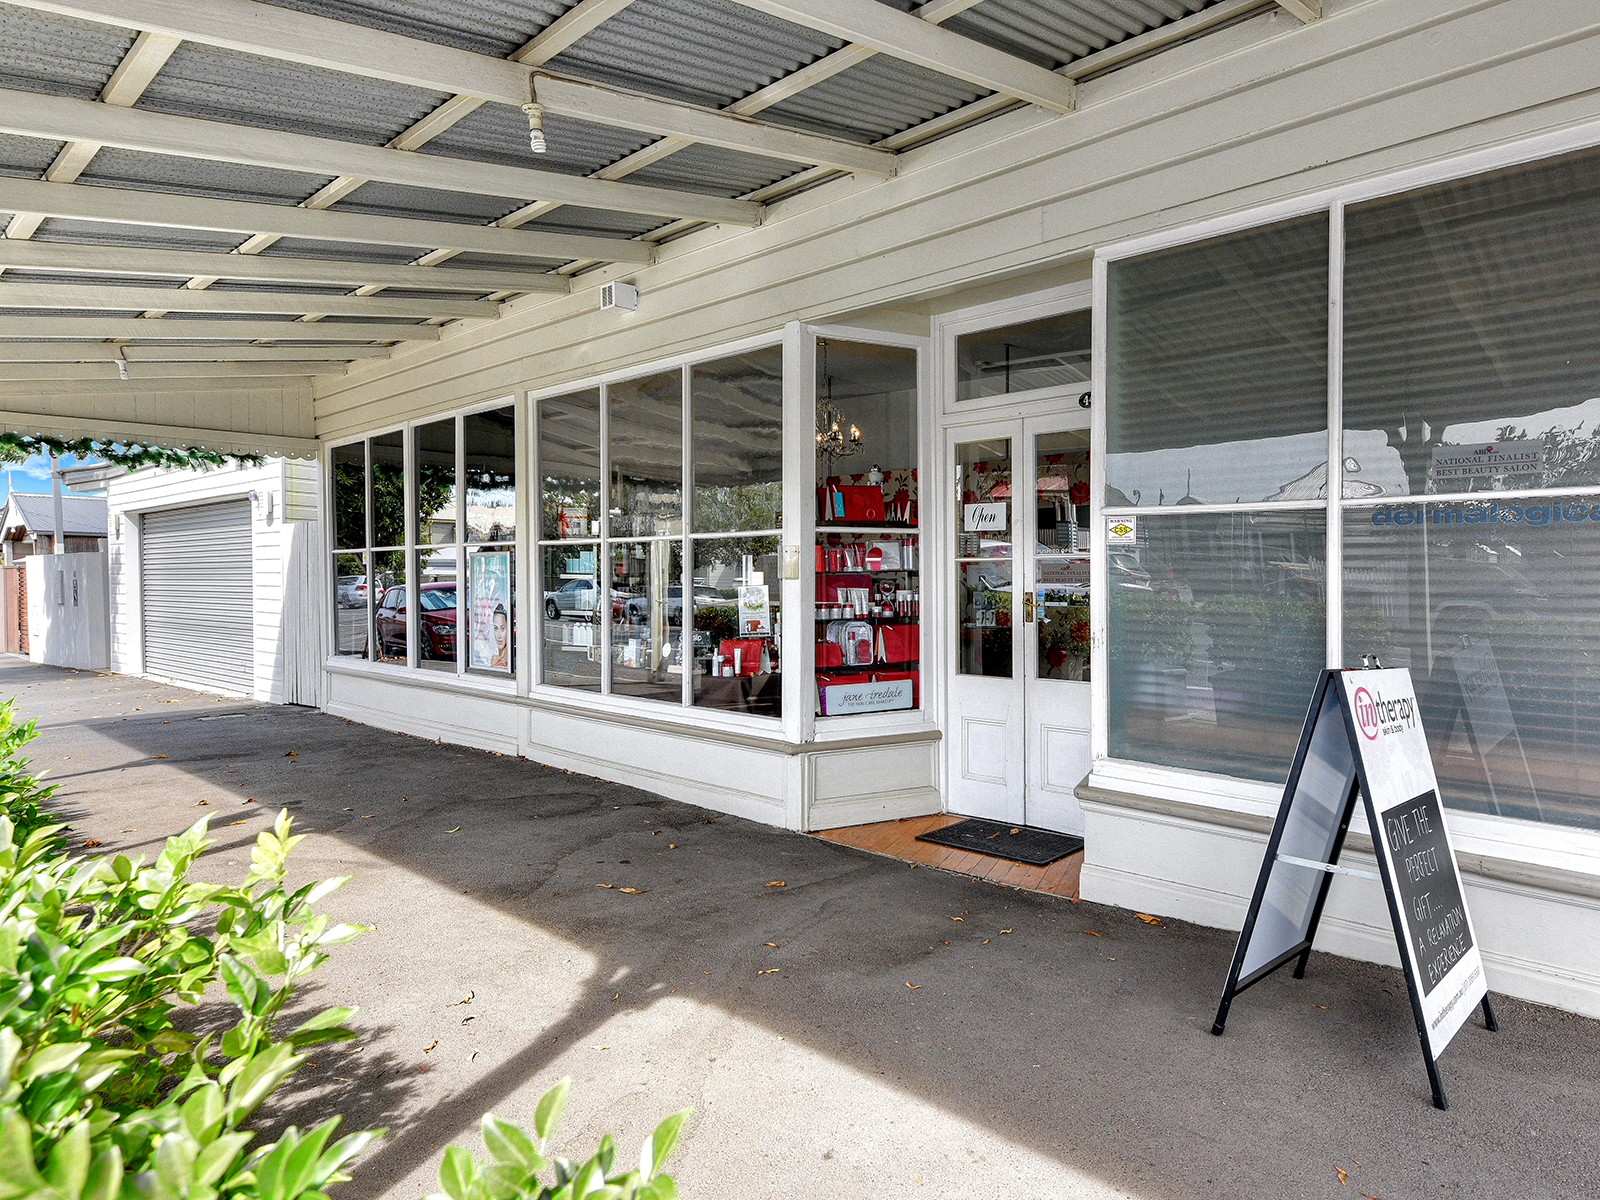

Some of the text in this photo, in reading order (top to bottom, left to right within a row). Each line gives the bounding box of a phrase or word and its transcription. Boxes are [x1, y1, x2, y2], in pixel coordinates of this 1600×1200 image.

[1436, 452, 1539, 466] NATIONAL FINALIST
[1436, 463, 1538, 477] BEST BEAUTY SALON
[972, 505, 997, 530] Open
[838, 692, 864, 707] jane
[865, 685, 903, 700] iredale
[1382, 726, 1391, 736] skin
[1394, 723, 1404, 734] body
[1387, 805, 1433, 851] GIVE THE
[1405, 846, 1439, 884] PERFECT
[1419, 904, 1463, 957] A RELAXATION
[1427, 932, 1467, 985] EXPERIENCE
